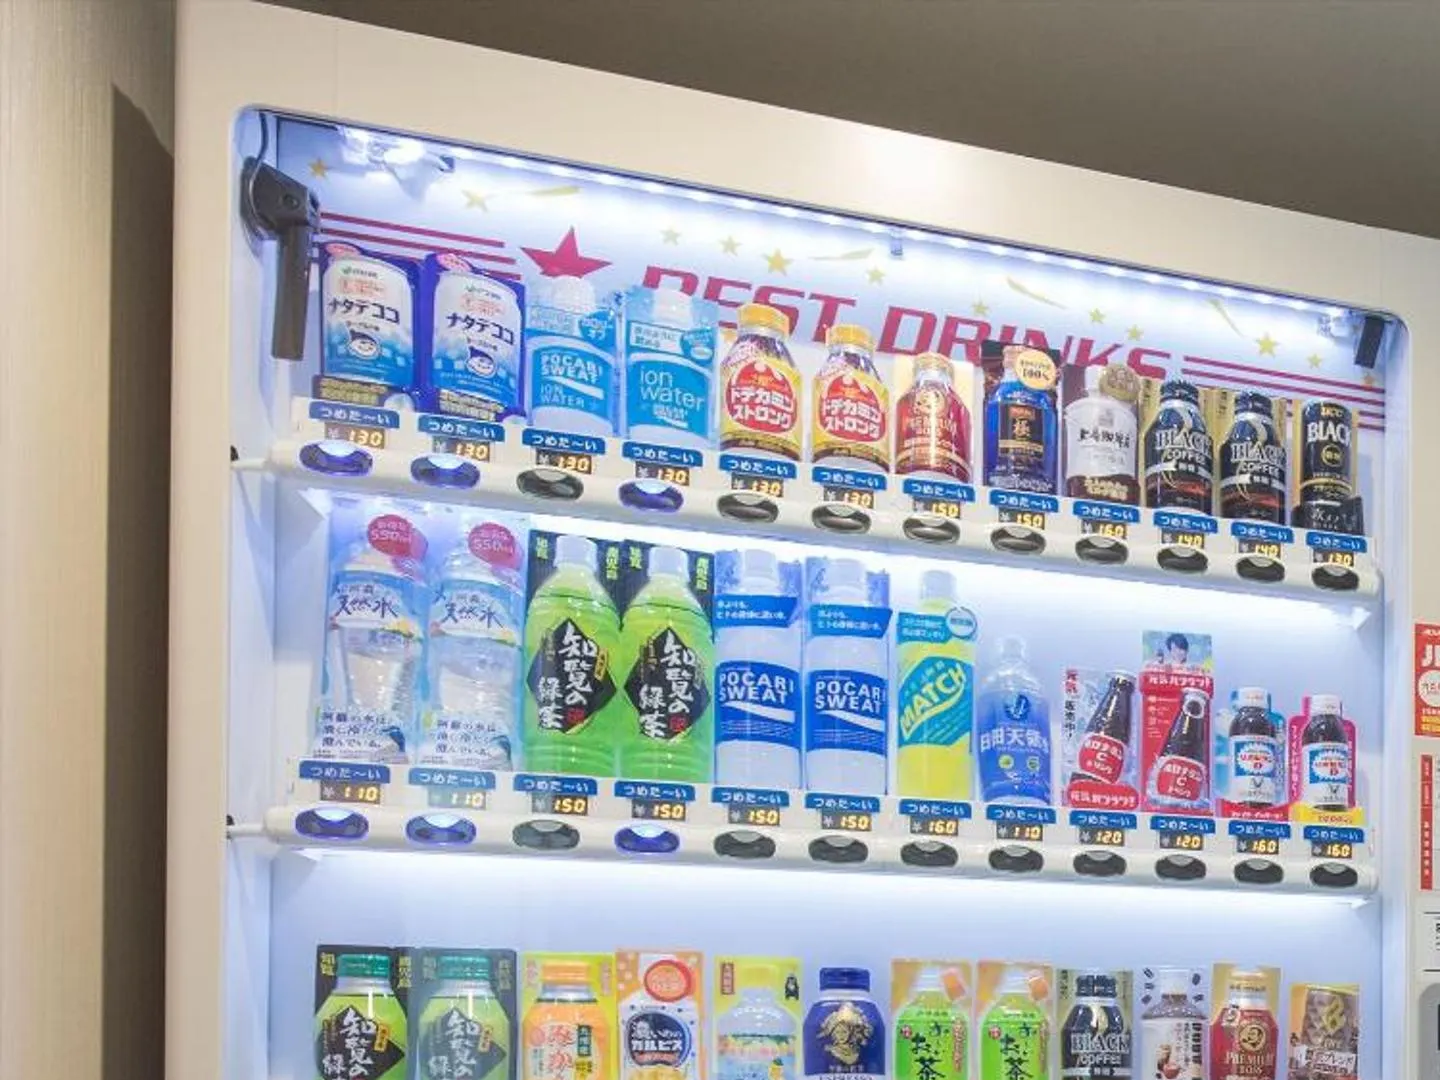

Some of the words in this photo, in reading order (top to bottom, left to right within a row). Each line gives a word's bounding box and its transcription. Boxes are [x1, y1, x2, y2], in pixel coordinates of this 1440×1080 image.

[329, 297, 399, 324] ナタデココ
[446, 311, 515, 345] ナタデココ
[640, 366, 673, 387] ion
[640, 385, 705, 412] water
[719, 671, 794, 693] POCARI
[719, 685, 788, 704] SWEAT
[814, 694, 883, 714] SWEAT
[554, 798, 586, 813] 150
[653, 804, 684, 819] 150
[749, 810, 779, 825] 150
[841, 815, 869, 829] 150
[927, 820, 956, 834] 160
[1097, 830, 1122, 844] 120
[1176, 836, 1200, 849] 120
[1253, 840, 1276, 853] 160
[1327, 844, 1350, 856] 160
